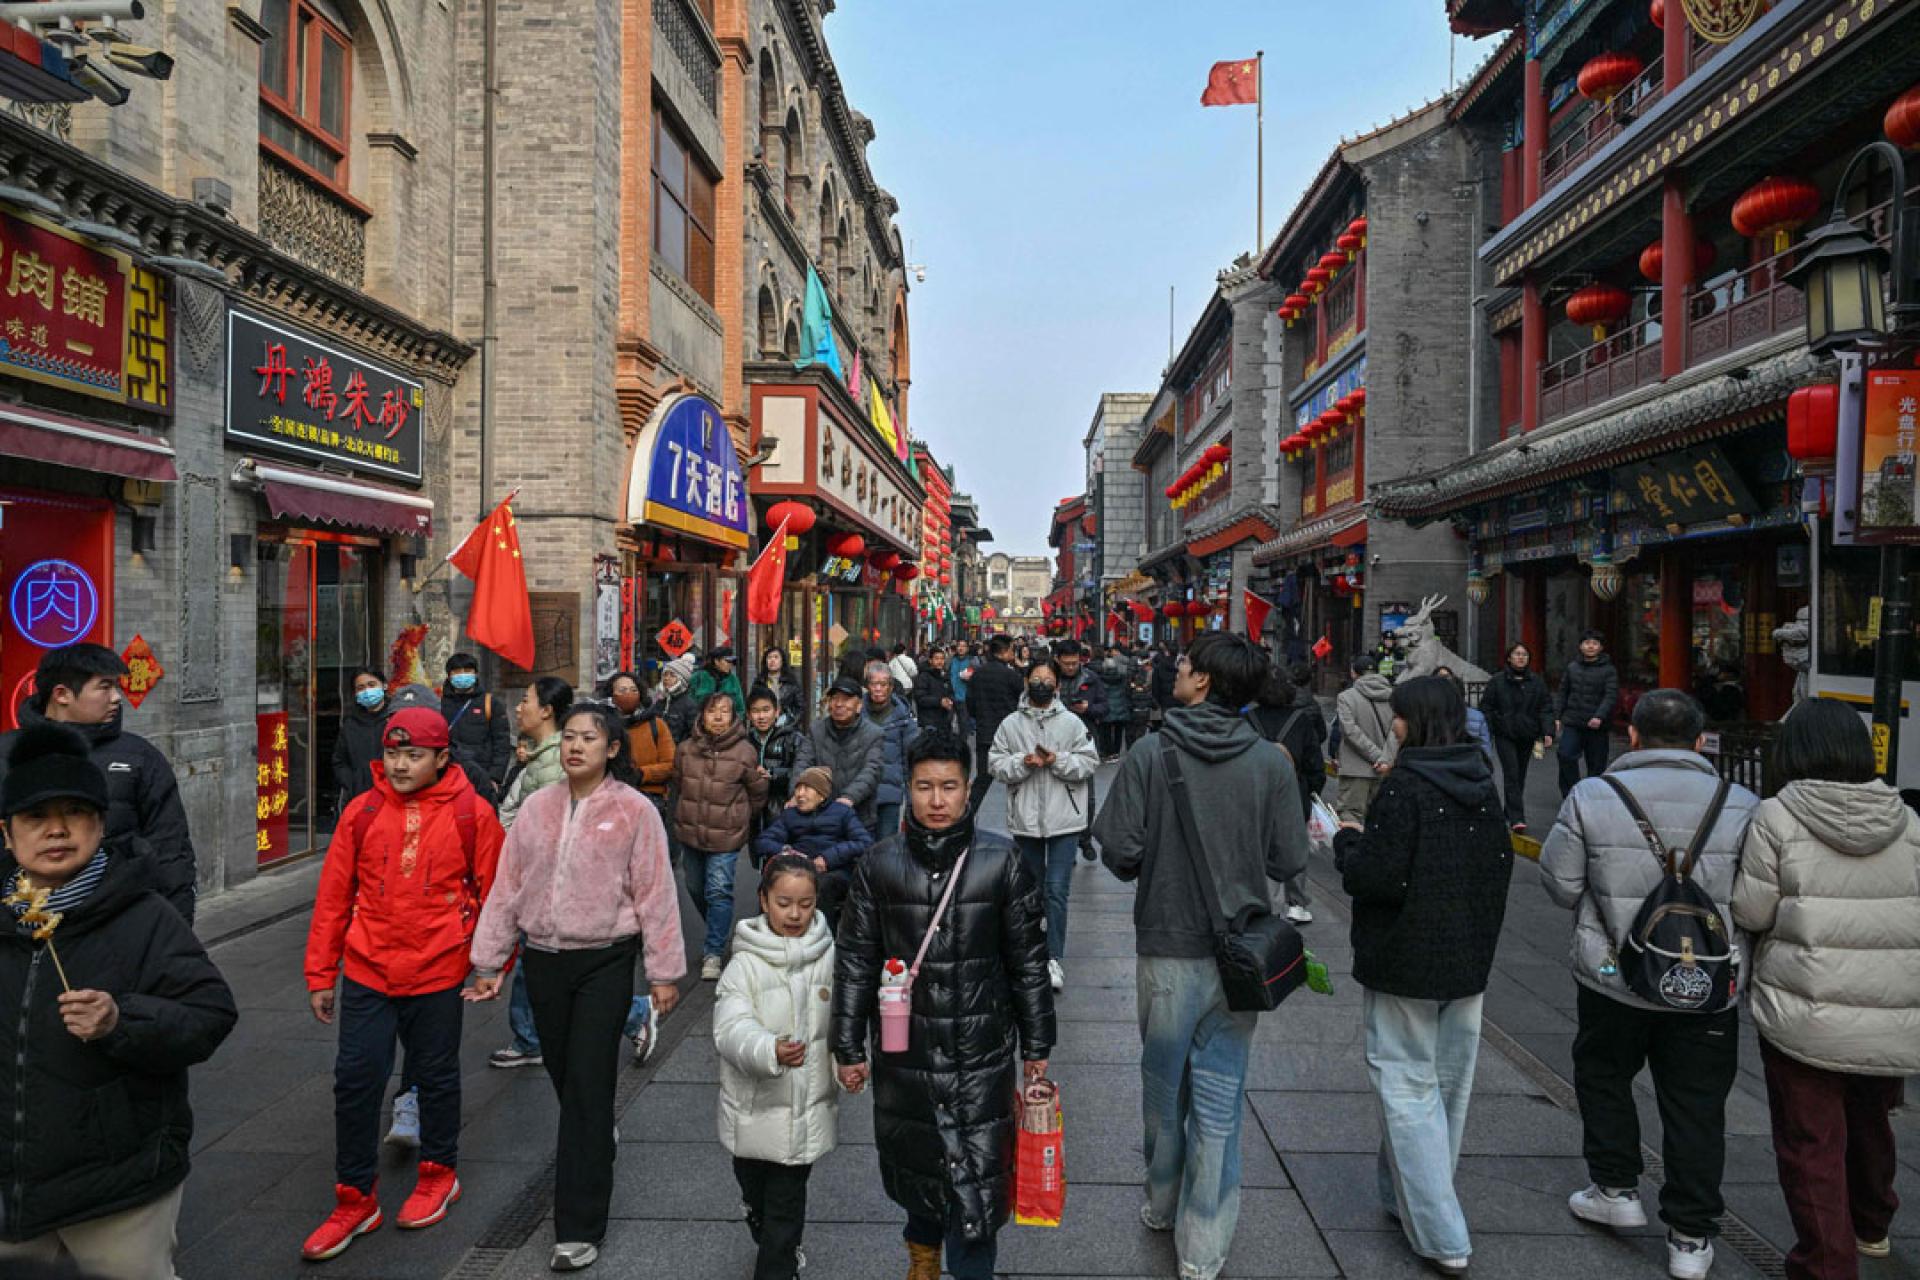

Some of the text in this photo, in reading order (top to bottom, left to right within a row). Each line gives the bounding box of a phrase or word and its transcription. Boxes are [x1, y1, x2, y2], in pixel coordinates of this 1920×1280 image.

[1897, 397, 1918, 465] 光盘行动
[668, 440, 739, 523] 7天酒店
[1637, 459, 1736, 517] 同仁堂
[27, 571, 79, 632] 肉
[666, 628, 684, 648] 福
